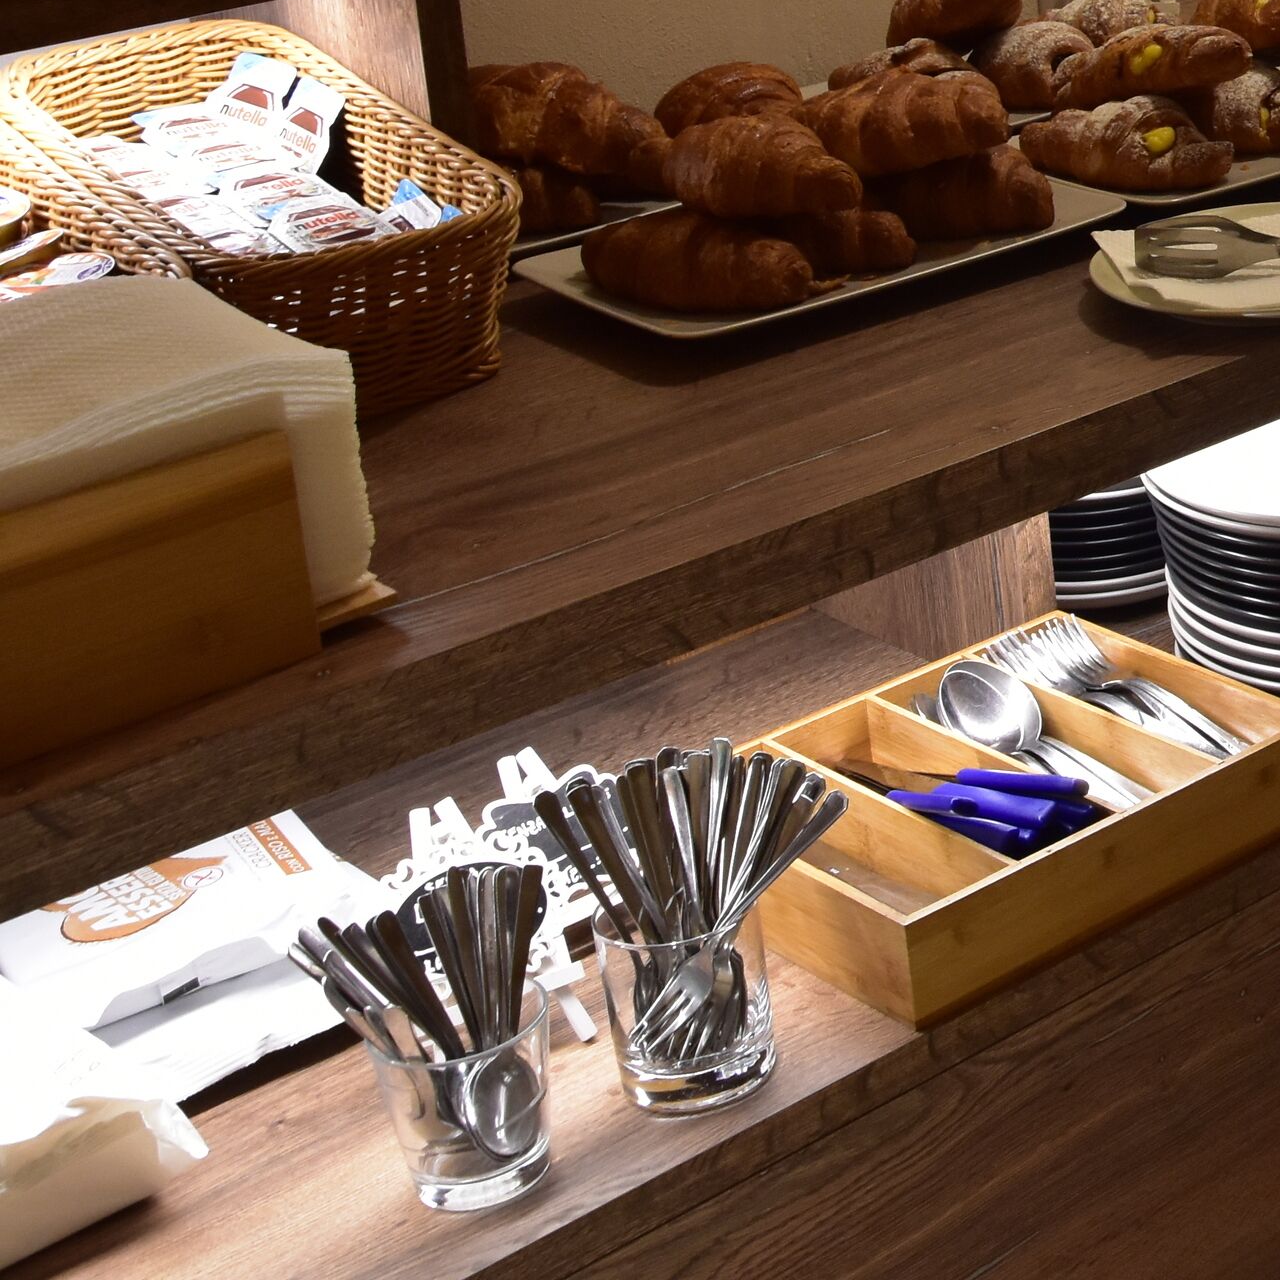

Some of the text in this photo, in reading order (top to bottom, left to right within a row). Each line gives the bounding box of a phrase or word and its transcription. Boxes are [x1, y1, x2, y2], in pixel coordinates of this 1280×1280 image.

[219, 103, 269, 127] nutella
[279, 127, 317, 154] nutella
[293, 210, 361, 232] nutella
[232, 831, 272, 869] CRACKER
[268, 840, 294, 861] RISO
